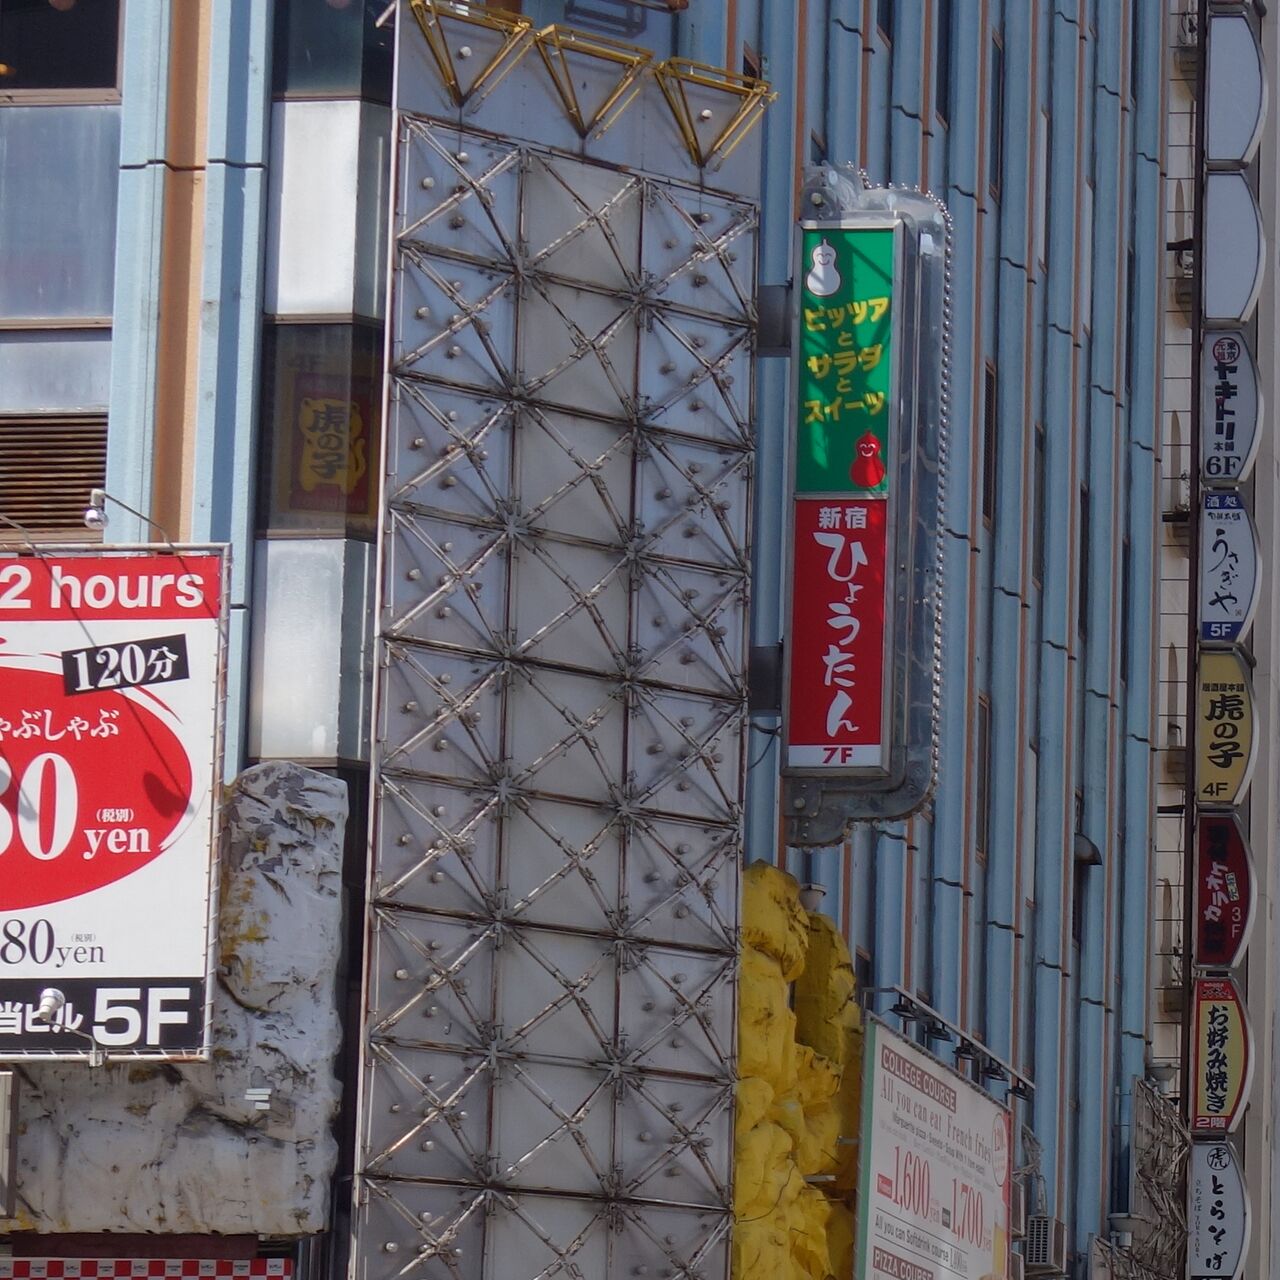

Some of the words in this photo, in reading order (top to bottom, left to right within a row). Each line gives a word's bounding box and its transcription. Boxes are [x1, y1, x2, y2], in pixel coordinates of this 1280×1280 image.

[808, 346, 882, 379] サラダ
[804, 392, 886, 425] スイーツ
[1212, 360, 1238, 440] ヤキトリ
[1205, 456, 1241, 477] 6F
[1206, 495, 1238, 508] 酒処
[817, 506, 867, 531] 新宿
[51, 565, 204, 609] hours
[812, 531, 867, 739] ひょうたん
[1210, 623, 1232, 637] 5F
[73, 644, 178, 691] 120分
[1204, 694, 1244, 768] 虎の子
[822, 747, 853, 765] 7F
[1203, 783, 1228, 797] 4F
[83, 825, 151, 860] yen
[56, 944, 105, 968] yen
[92, 987, 190, 1046] 5F
[1205, 1004, 1229, 1113] お好み焼き
[882, 1049, 921, 1089] COLLEGE
[923, 1075, 956, 1108] COURSE
[1196, 1117, 1226, 1128] 2階
[1206, 1173, 1227, 1271] とらそば
[874, 1250, 899, 1276] PIZZA
